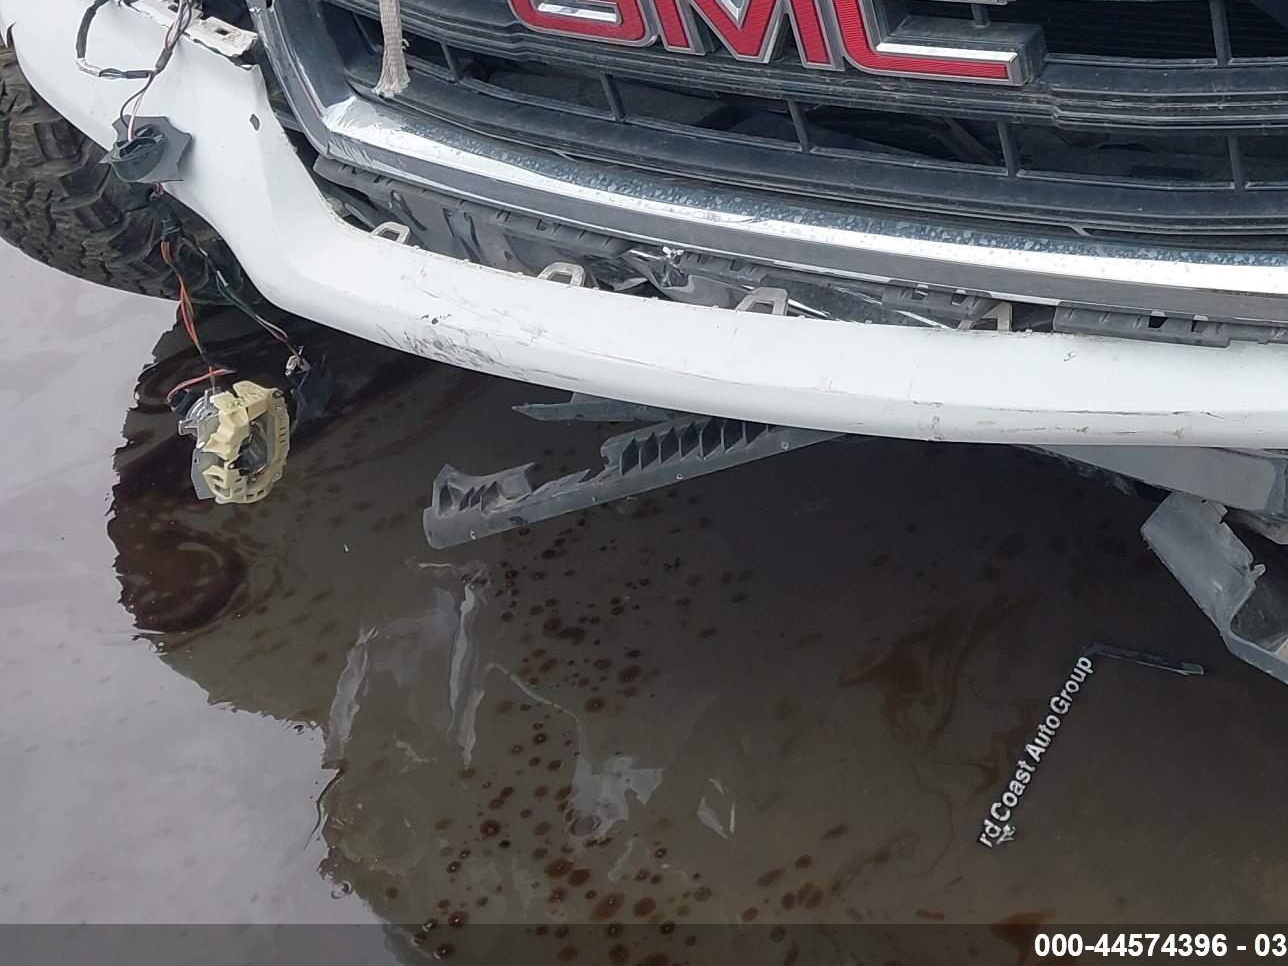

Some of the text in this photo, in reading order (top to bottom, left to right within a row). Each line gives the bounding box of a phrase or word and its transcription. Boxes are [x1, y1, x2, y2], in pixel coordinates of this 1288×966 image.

[989, 760, 1036, 822] Coast
[1024, 714, 1061, 763] Auto
[1050, 656, 1094, 715] Group
